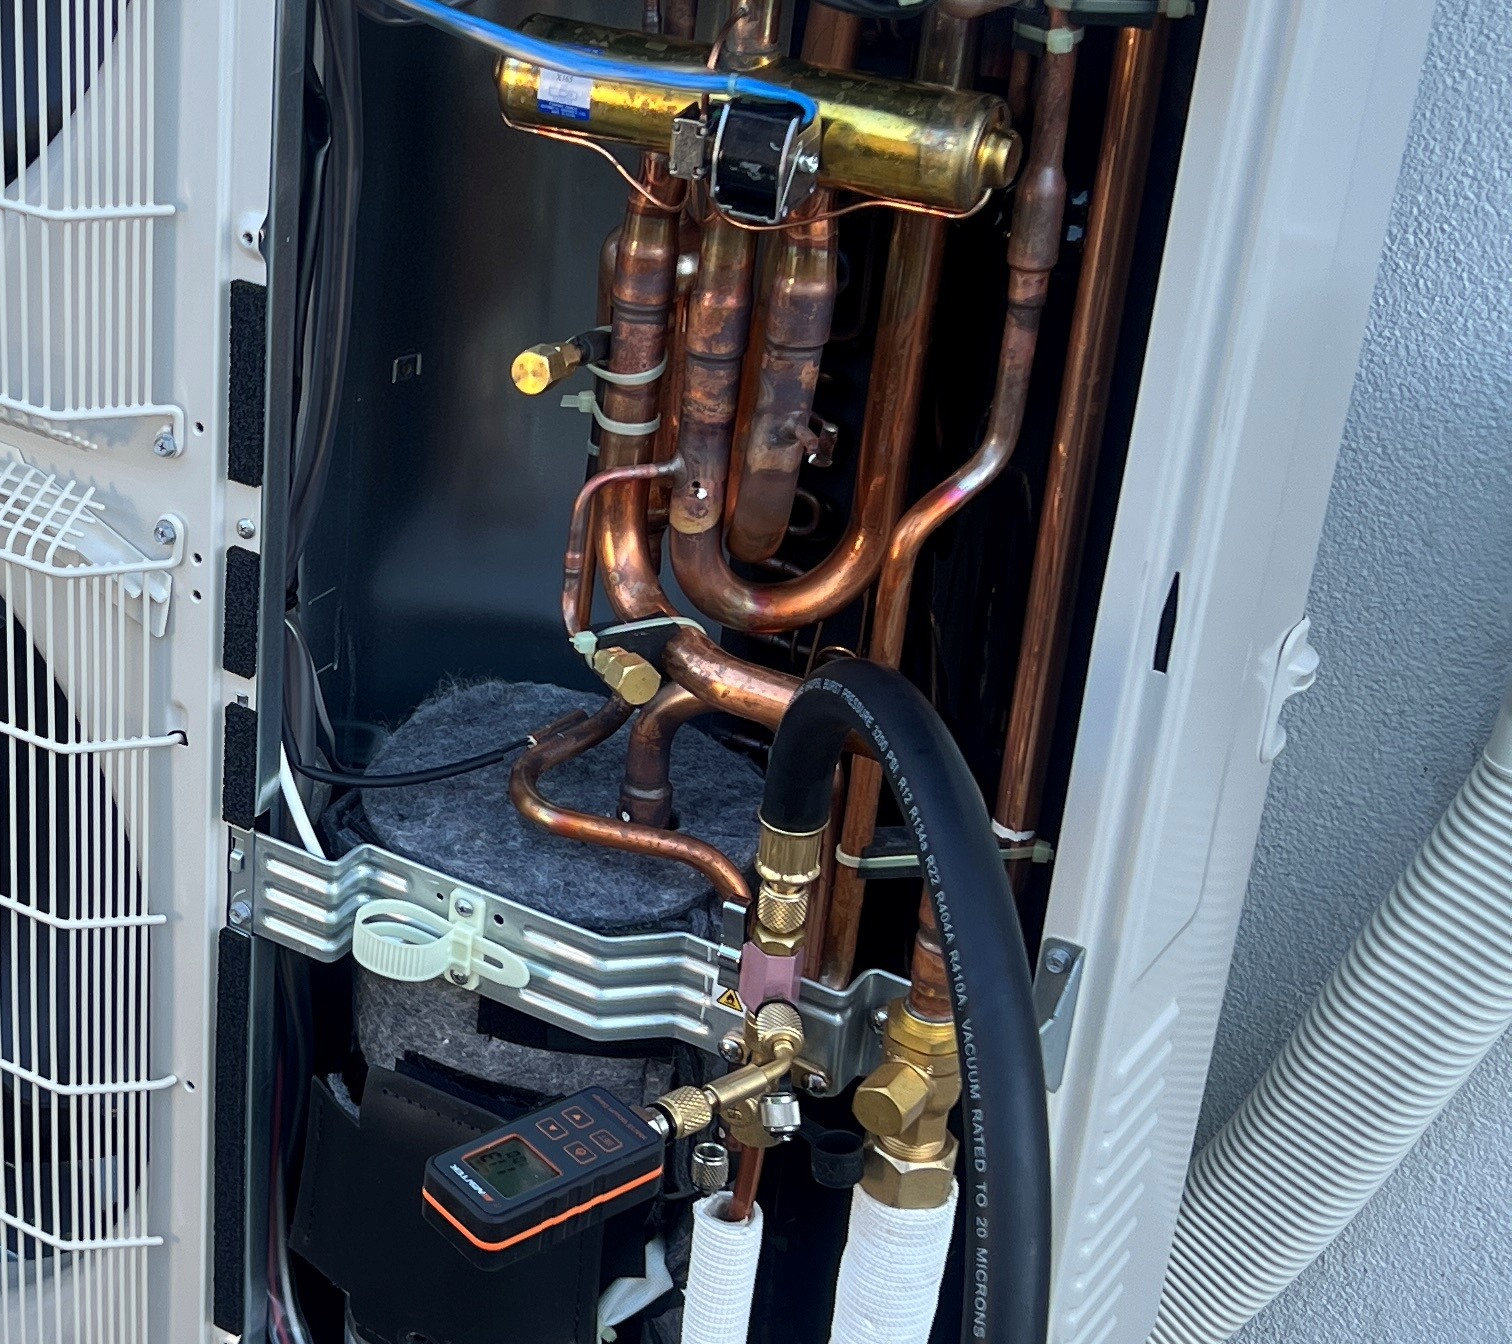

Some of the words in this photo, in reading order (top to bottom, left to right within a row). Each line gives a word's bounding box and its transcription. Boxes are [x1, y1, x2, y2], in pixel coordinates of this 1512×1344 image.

[841, 687, 875, 729] PRESSURE
[897, 776, 914, 805] R12
[908, 805, 929, 852] R134a
[925, 854, 942, 886] R22
[935, 890, 956, 945] R404A
[960, 1017, 981, 1100] VACUUM
[970, 1108, 987, 1173] RATED
[974, 1181, 988, 1208] TO
[975, 1216, 989, 1239] 20
[972, 1245, 989, 1340] MICRONS
